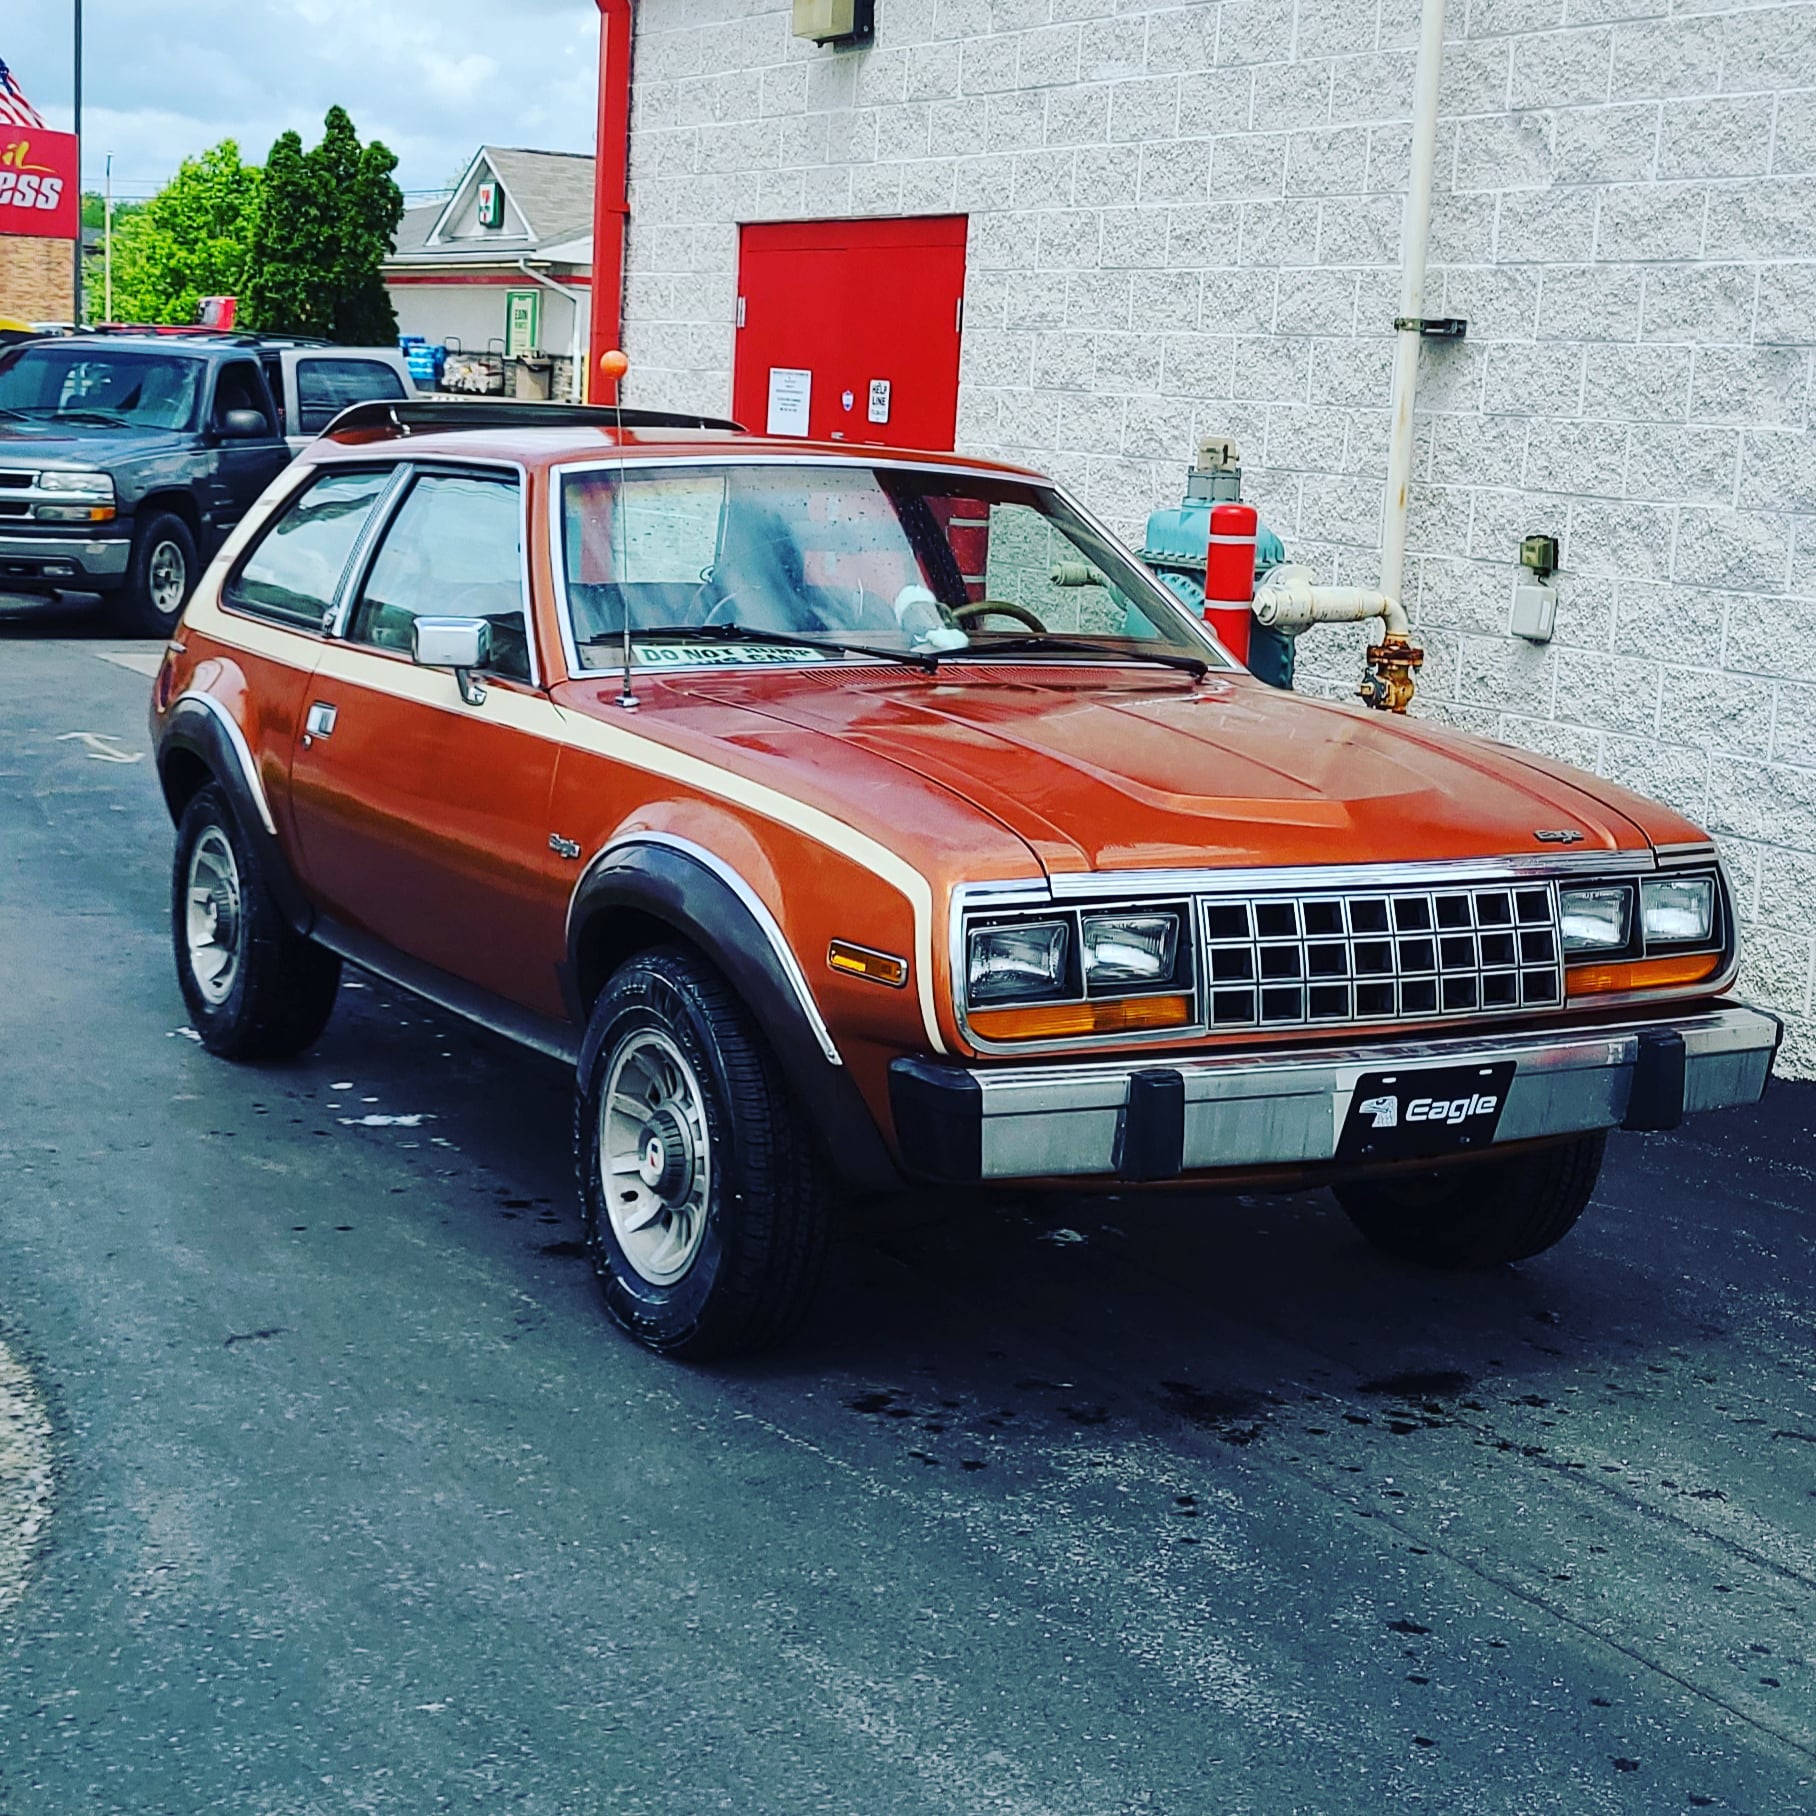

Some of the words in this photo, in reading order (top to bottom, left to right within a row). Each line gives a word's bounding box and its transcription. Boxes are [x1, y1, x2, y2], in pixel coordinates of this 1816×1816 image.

[642, 648, 679, 662] DO
[681, 648, 734, 661] NOT
[1405, 1093, 1498, 1125] Eagle
